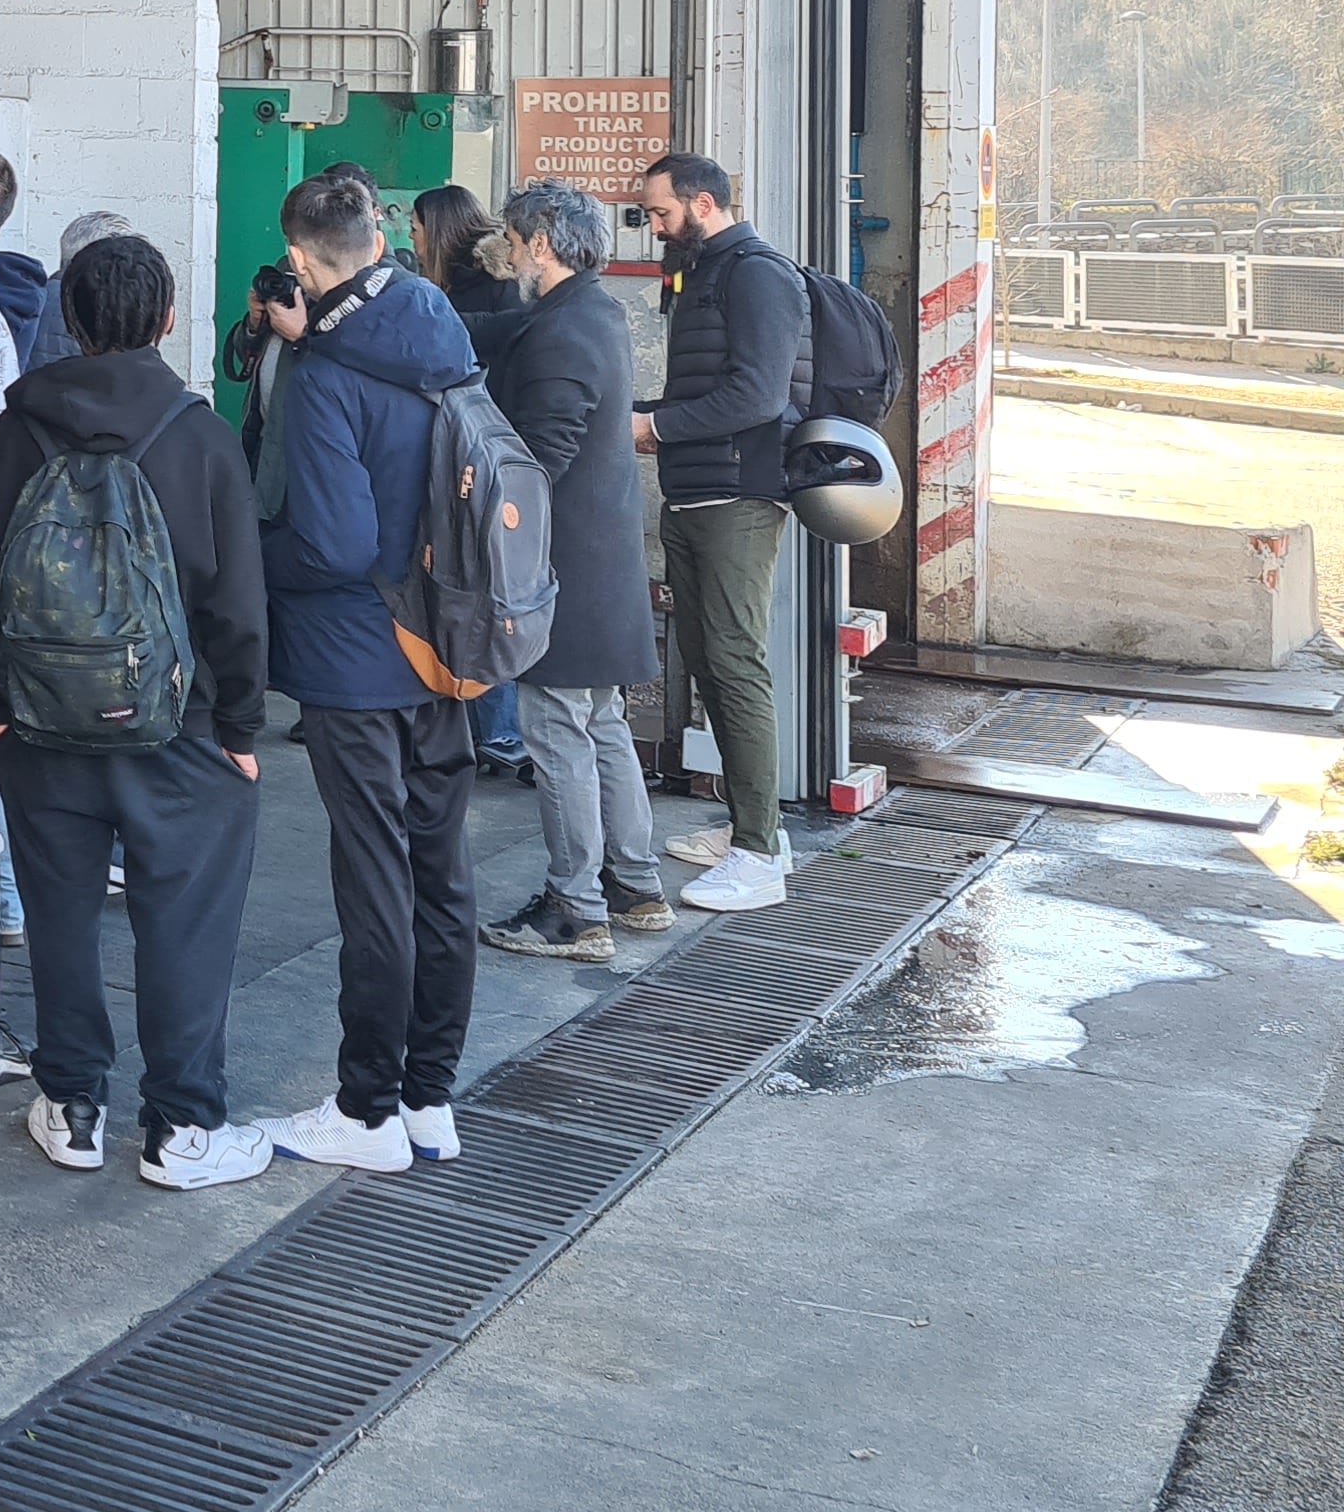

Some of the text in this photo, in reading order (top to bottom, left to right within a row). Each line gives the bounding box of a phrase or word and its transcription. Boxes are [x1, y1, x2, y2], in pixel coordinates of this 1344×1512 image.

[574, 117, 643, 133] TIRAR
[535, 156, 648, 173] QUIMICOS
[524, 176, 644, 193] CMPACTA
